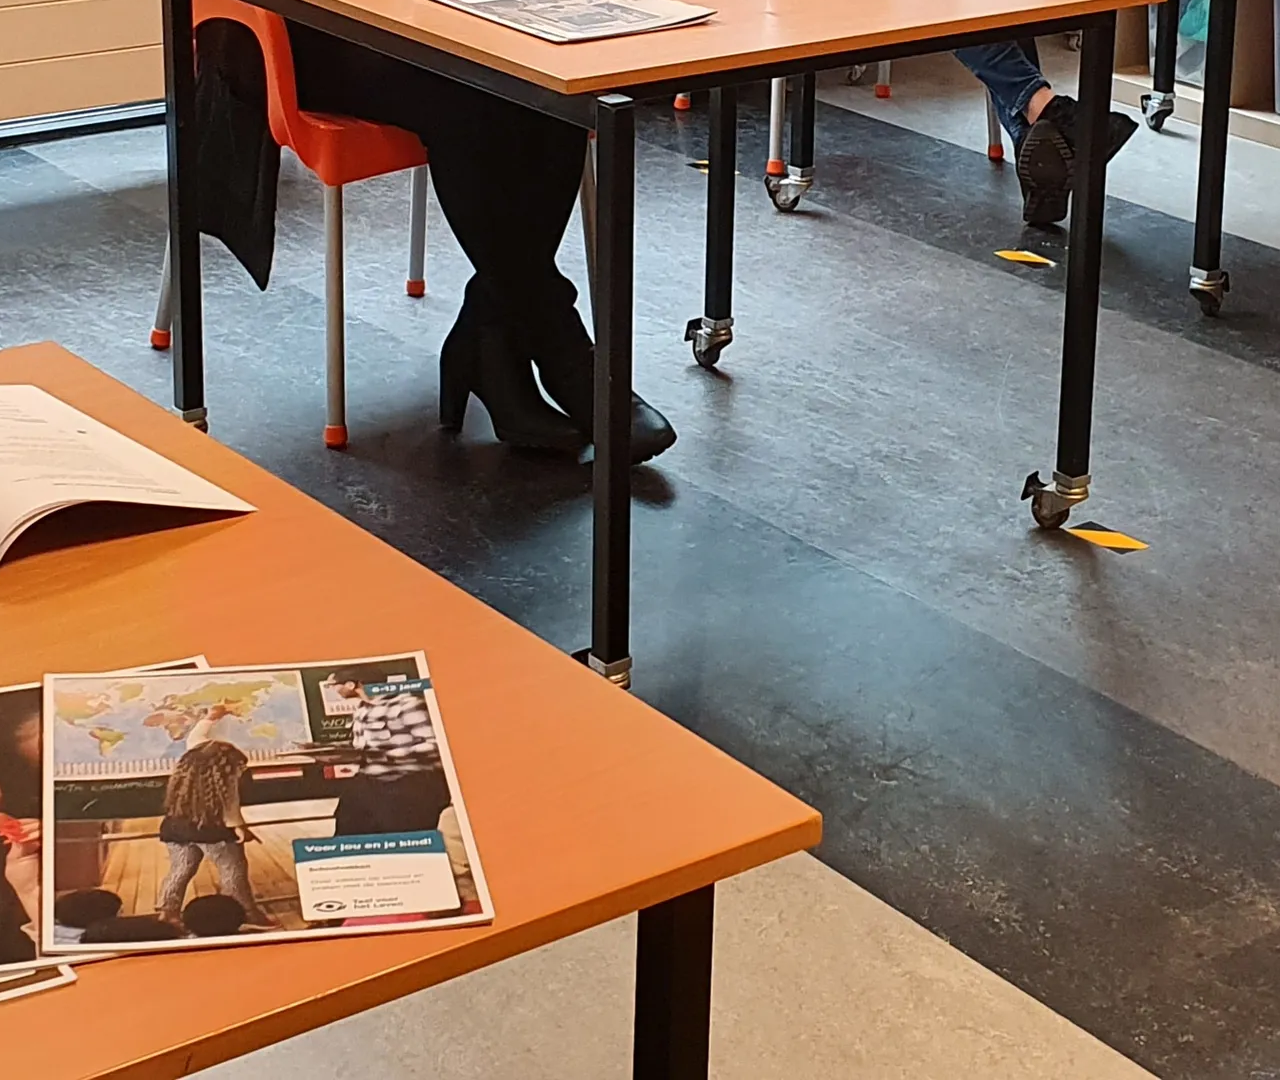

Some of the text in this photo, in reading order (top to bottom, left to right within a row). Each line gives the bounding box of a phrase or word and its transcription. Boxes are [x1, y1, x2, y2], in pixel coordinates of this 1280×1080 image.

[304, 844, 336, 852] Voor
[340, 842, 361, 851] jou
[364, 842, 381, 850] en
[384, 840, 396, 849] je
